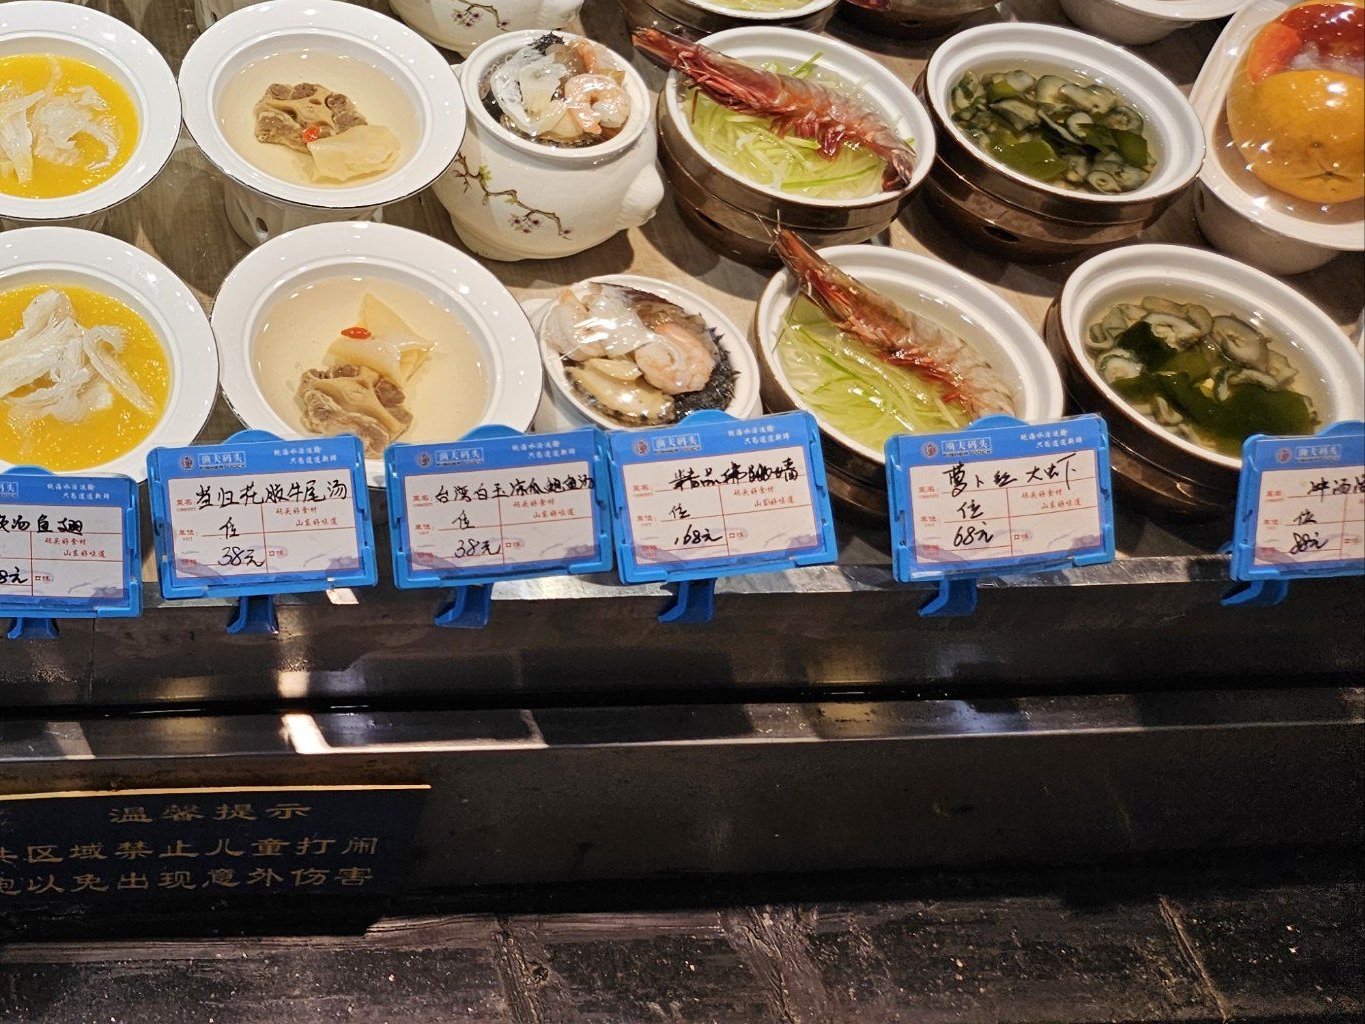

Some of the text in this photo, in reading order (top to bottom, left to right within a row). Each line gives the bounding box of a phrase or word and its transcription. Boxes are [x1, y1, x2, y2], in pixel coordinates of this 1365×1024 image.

[654, 434, 698, 450] 渔夫码头
[944, 438, 989, 453] 渔夫码头
[200, 452, 243, 465] 渔夫码头
[438, 448, 481, 462] 渔夫码头
[669, 457, 798, 491] 精品佛跳墙
[943, 453, 1076, 497] 萝卜丝大虾
[196, 480, 348, 509] 当归花胶牛尾汤
[754, 495, 795, 509] 山东好味道
[533, 508, 575, 520] 山东好味道
[669, 503, 690, 519] 位
[957, 499, 984, 519] 位
[1041, 498, 1082, 511] 山东好味道
[296, 517, 338, 528] 山东好味道
[452, 510, 475, 530] 位
[1293, 508, 1317, 526] 位
[219, 517, 240, 540] 位
[675, 524, 723, 545] 168元
[954, 522, 993, 546] 68元
[455, 539, 501, 558] 38元
[1290, 532, 1328, 554] 88元
[64, 549, 106, 558] 山东好味道
[218, 546, 264, 567] 38元
[110, 802, 311, 824] 温馨提示
